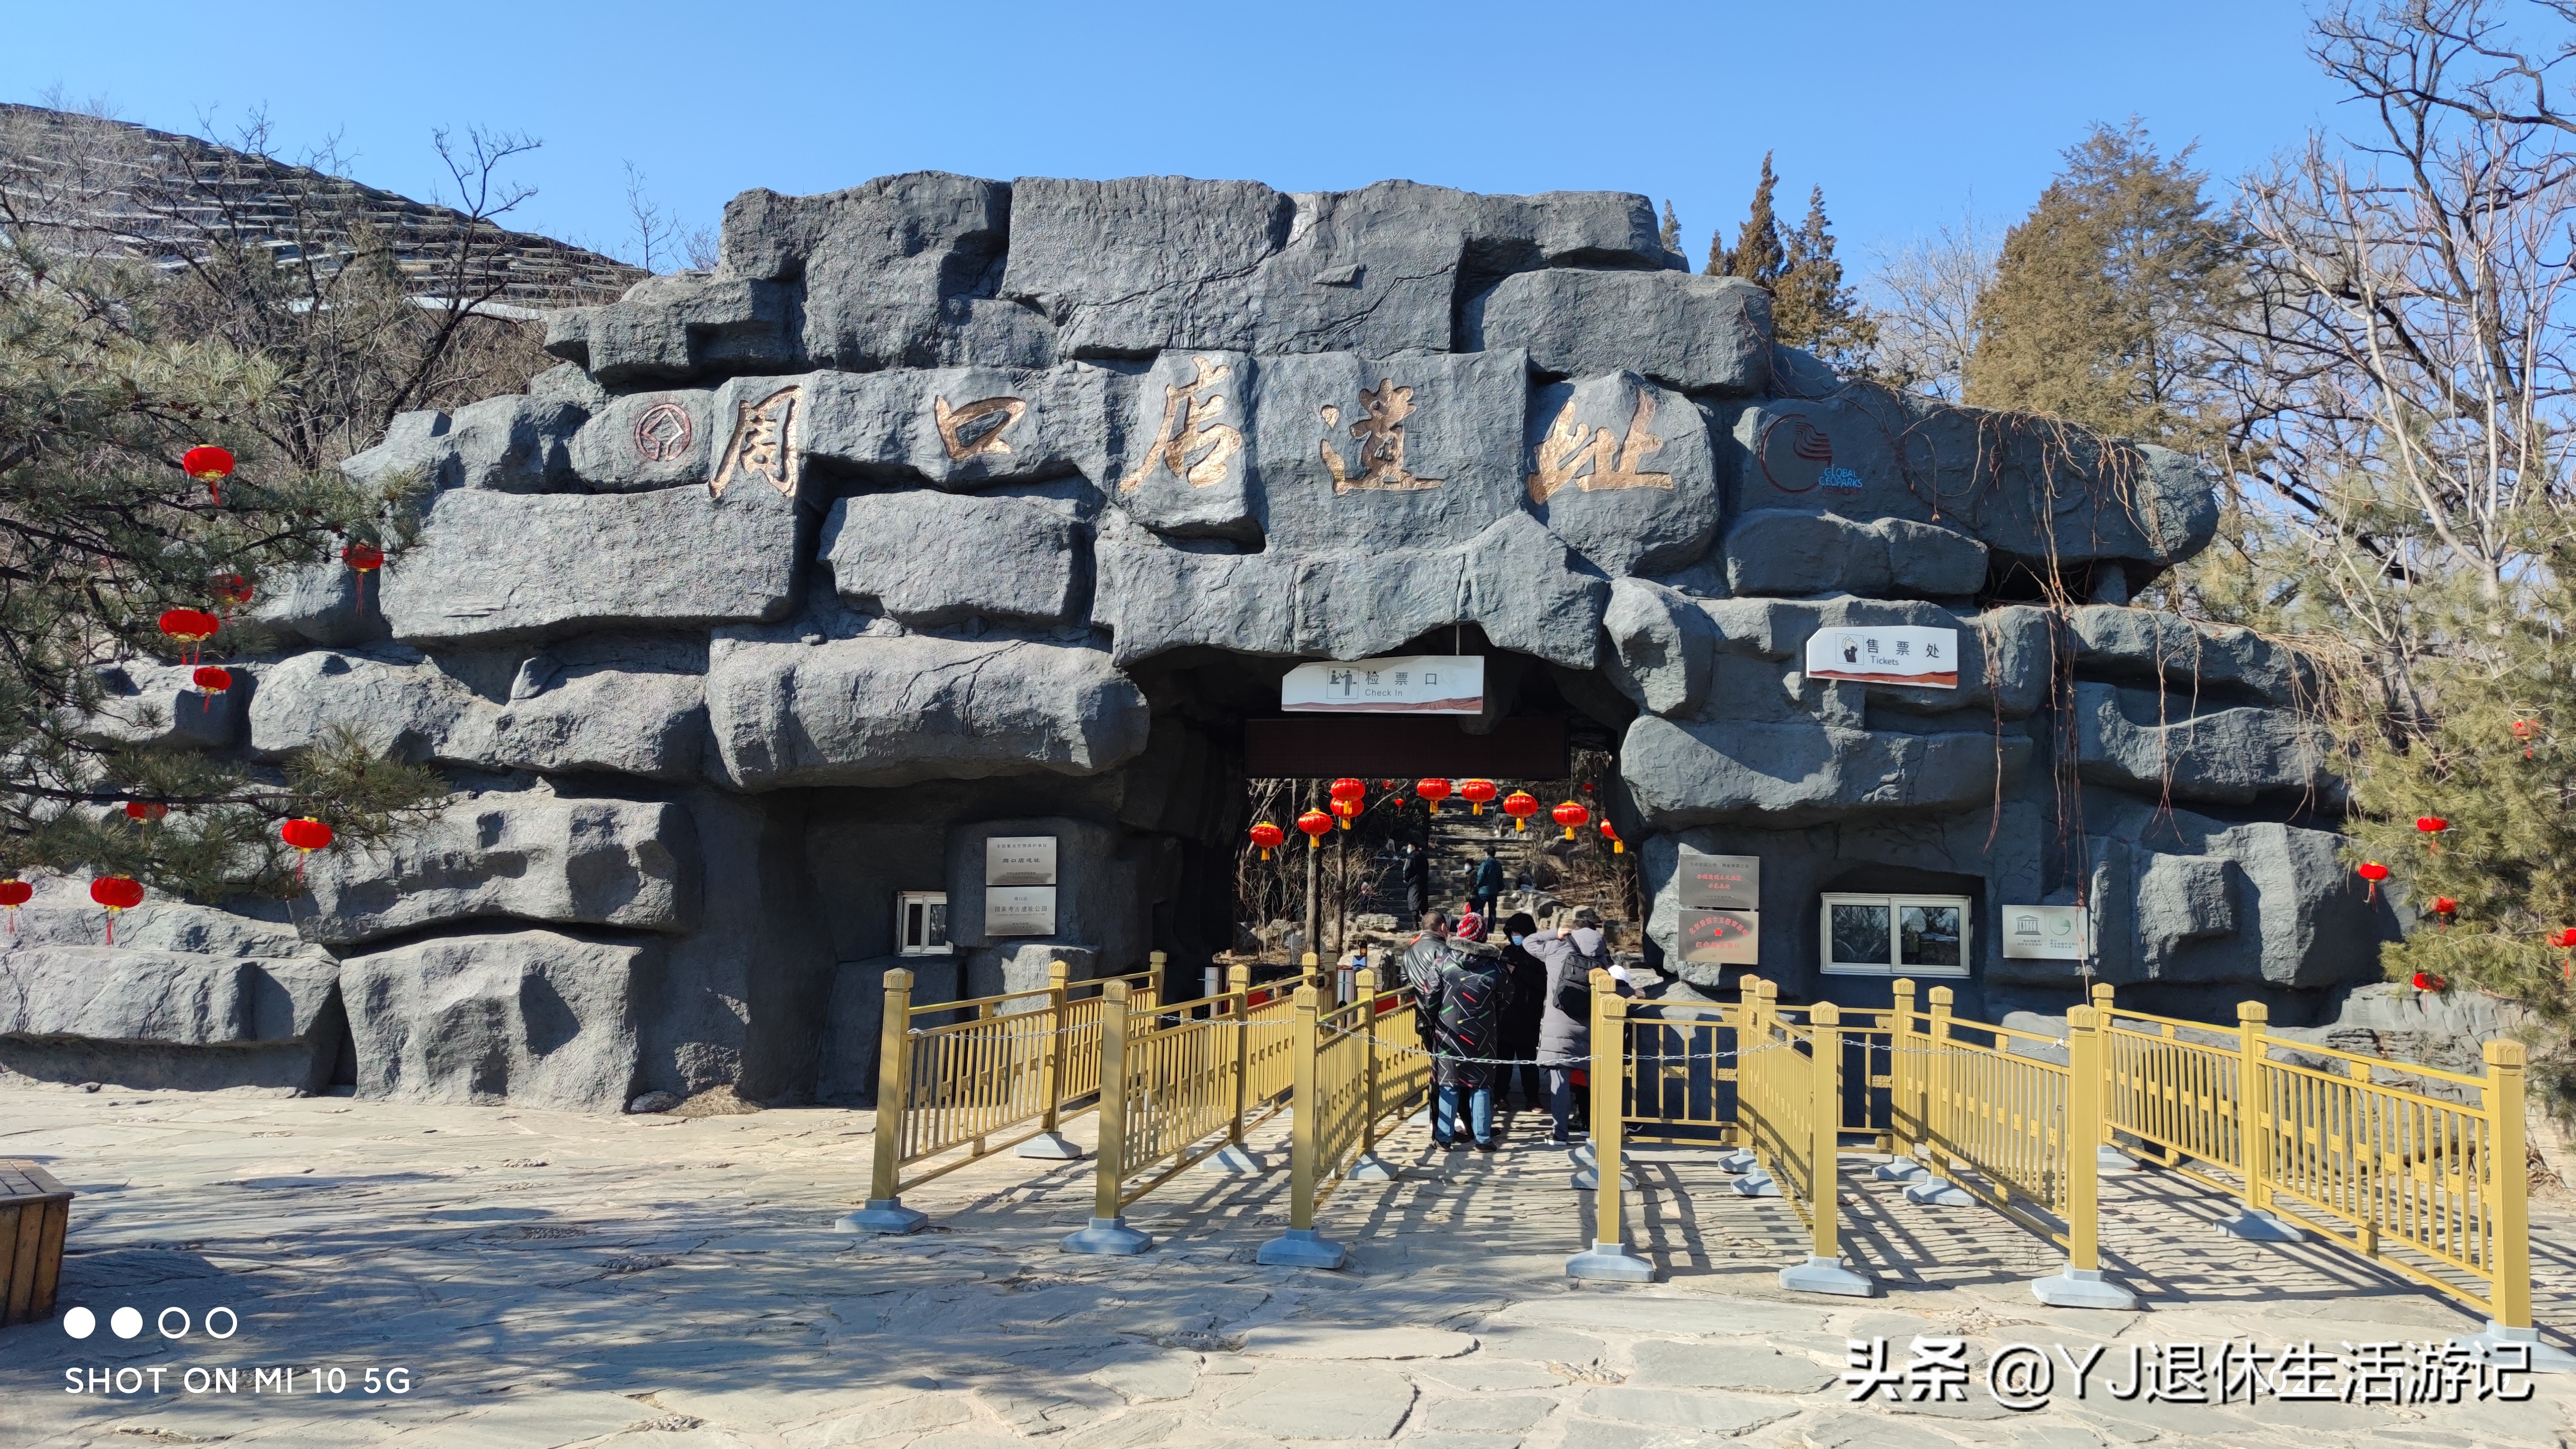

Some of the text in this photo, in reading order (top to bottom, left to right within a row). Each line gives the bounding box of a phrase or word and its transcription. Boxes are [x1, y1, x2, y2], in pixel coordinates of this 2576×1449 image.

[709, 355, 1675, 505] 周口店遗址
[1824, 464, 1856, 477] GLOBAL
[1819, 476, 1863, 487] GEOPARKS
[1866, 638, 1940, 658] 售票处
[1870, 655, 1899, 666] Tickets
[1365, 671, 1437, 686] 检票口
[1365, 688, 1392, 697] Check
[2017, 921, 2038, 931] UNESCO
